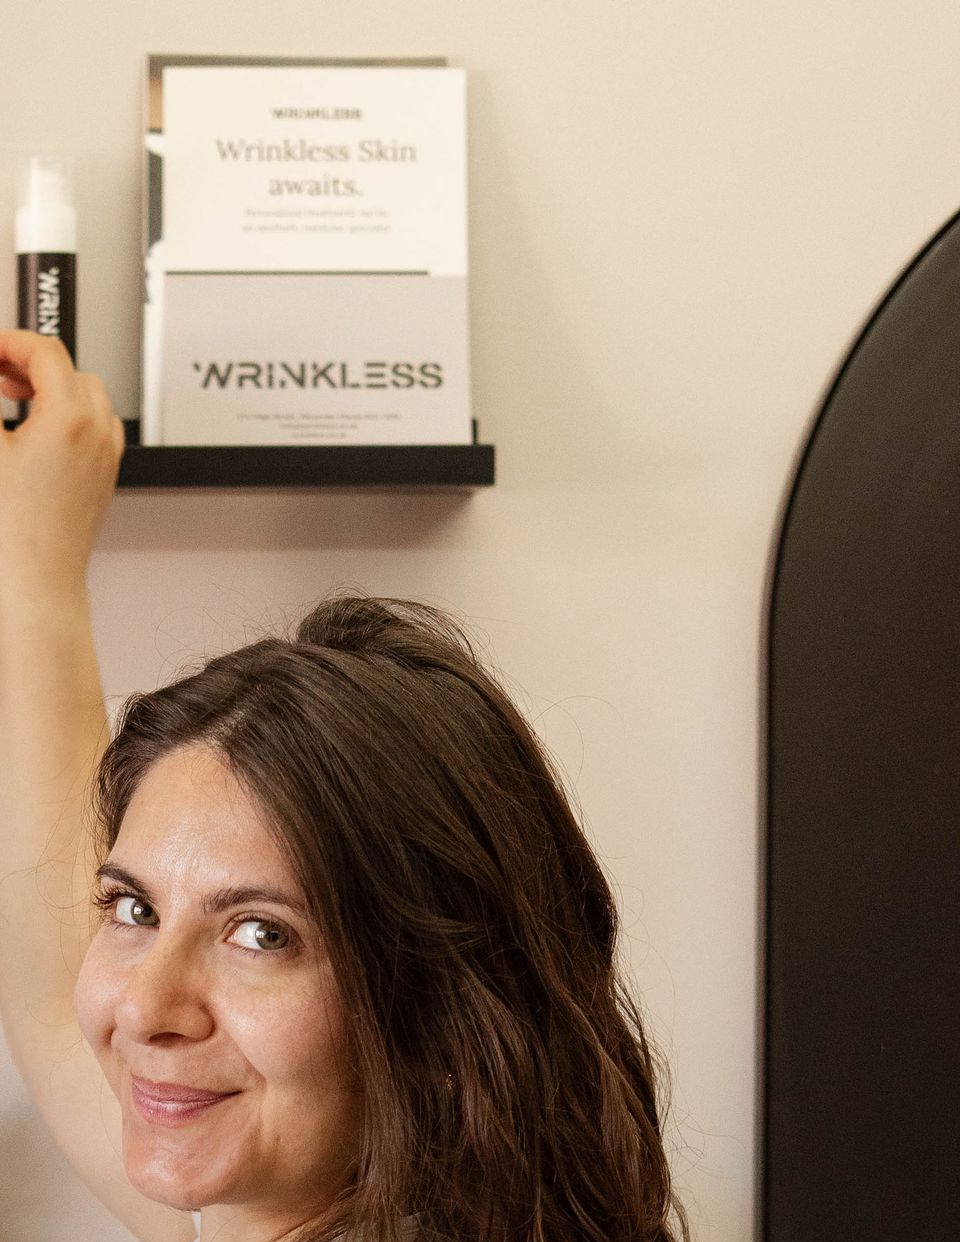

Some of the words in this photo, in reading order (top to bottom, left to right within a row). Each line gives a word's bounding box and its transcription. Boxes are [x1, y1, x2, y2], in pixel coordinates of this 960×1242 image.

[270, 106, 363, 121] WRINKLESS
[215, 138, 351, 164] Wrinkless
[357, 138, 418, 163] Skin
[268, 174, 364, 198] awaits.
[192, 361, 445, 391] WRINKLESS
